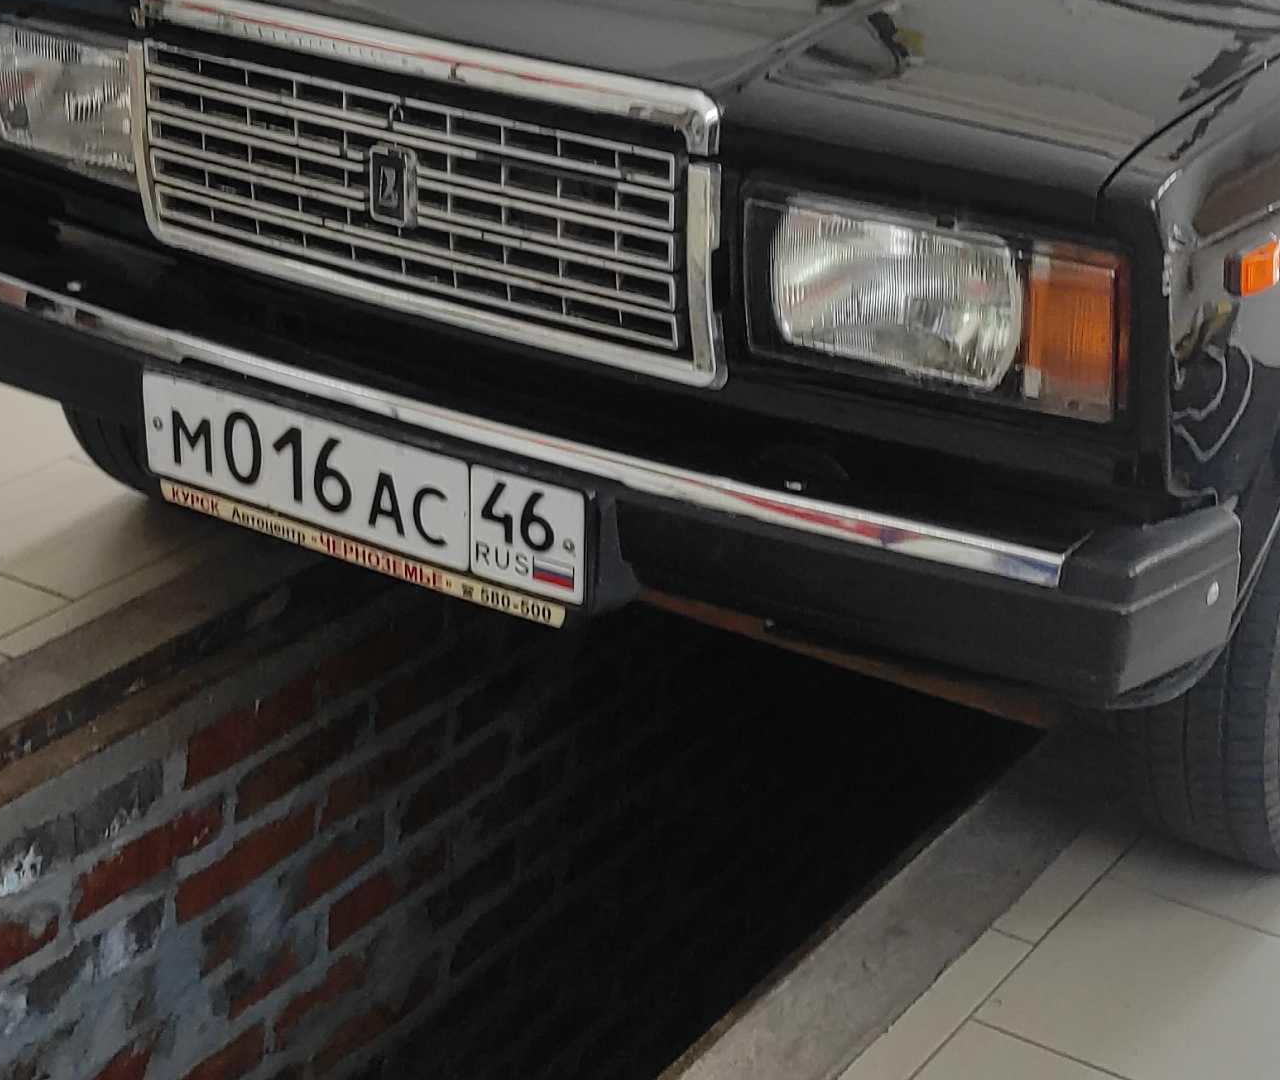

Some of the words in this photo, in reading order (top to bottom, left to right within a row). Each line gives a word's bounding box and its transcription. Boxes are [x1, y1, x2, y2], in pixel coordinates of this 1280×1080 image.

[171, 485, 220, 515] КУРСК
[481, 482, 555, 552] 46
[475, 540, 530, 577] RUS
